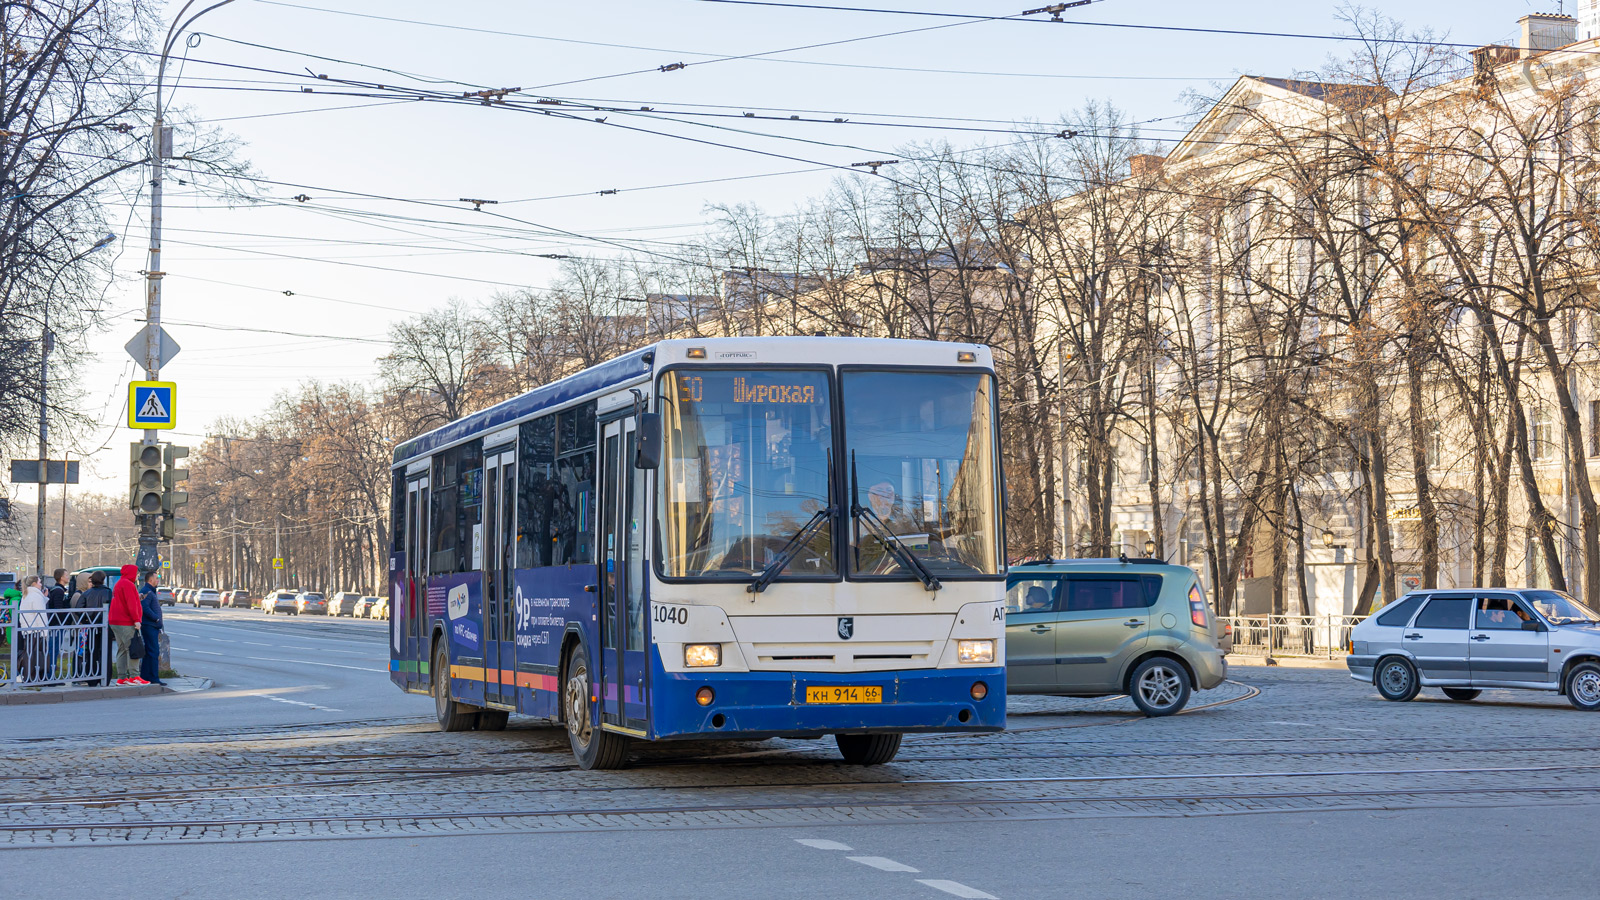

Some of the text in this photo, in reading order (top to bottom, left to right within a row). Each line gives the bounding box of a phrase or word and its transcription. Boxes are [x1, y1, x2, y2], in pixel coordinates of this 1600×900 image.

[680, 376, 815, 403] 50 Широкая
[550, 597, 570, 610] транспорте
[653, 605, 688, 625] 1040
[813, 688, 877, 701] КН 914 66
